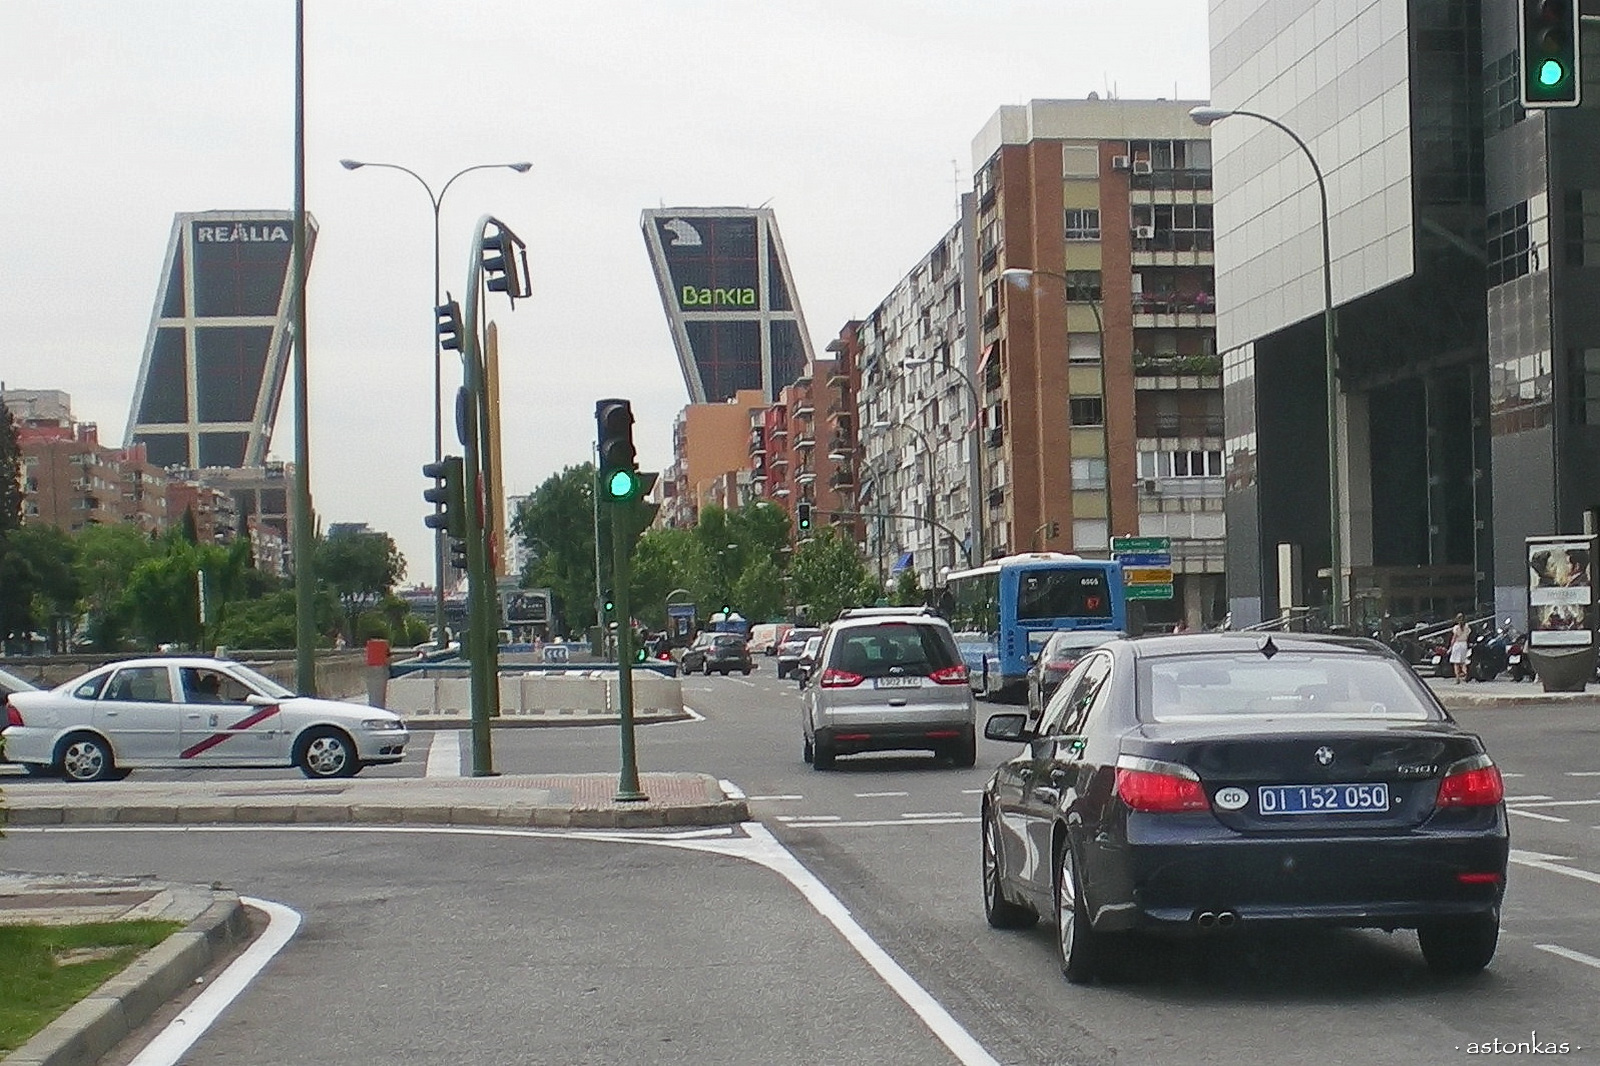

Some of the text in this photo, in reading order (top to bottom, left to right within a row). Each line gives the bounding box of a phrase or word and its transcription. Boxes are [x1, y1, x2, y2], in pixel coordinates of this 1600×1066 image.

[198, 224, 289, 242] REALIA
[682, 285, 756, 306] Bankia
[1223, 793, 1241, 803] CD
[1299, 787, 1338, 809] 152
[1345, 786, 1385, 807] 050
